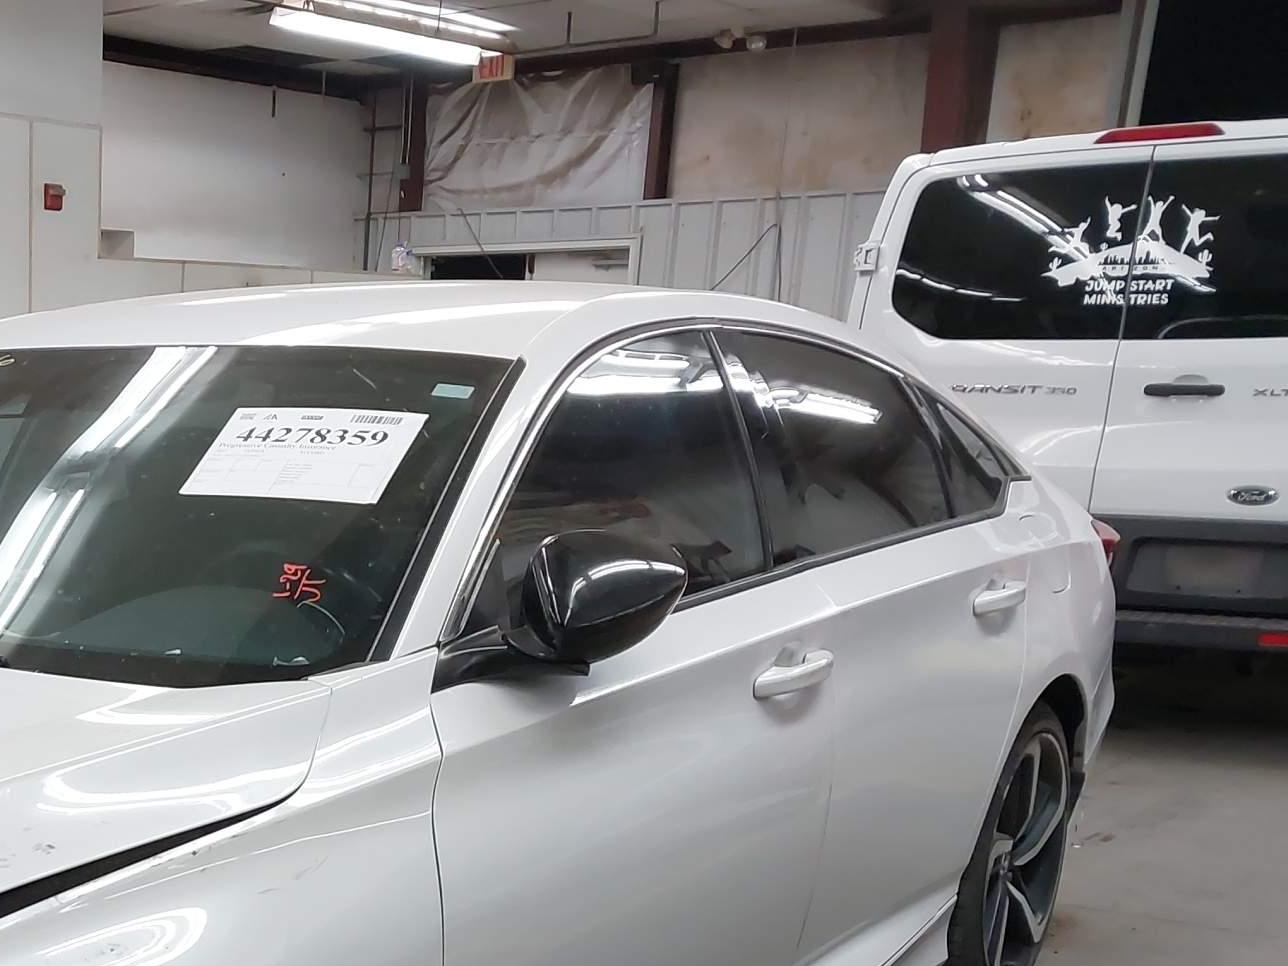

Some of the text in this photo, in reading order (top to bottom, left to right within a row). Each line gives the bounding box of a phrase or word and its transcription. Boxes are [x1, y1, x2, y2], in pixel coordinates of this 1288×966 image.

[1085, 279, 1175, 292] JUMP START
[951, 383, 1043, 395] RANSIT
[235, 427, 389, 447] 44278359
